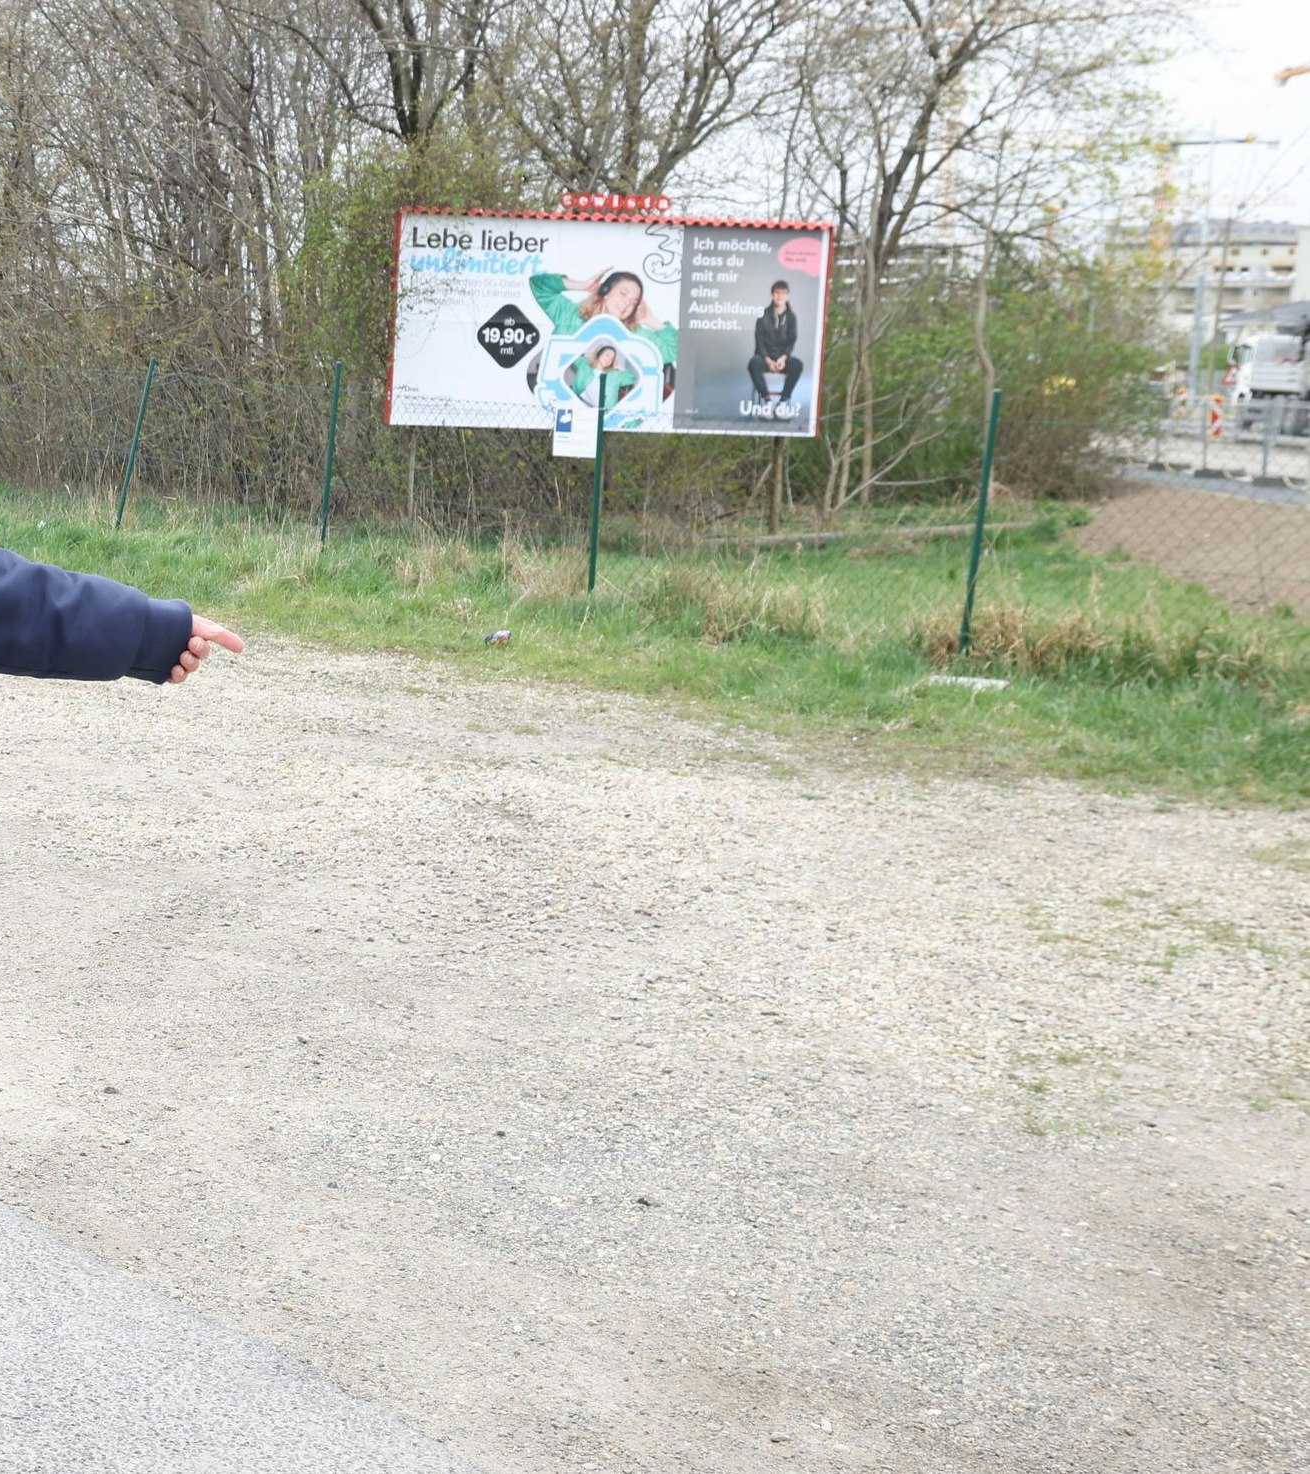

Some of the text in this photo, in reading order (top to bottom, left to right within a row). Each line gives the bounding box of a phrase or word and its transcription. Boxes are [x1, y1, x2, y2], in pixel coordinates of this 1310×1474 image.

[412, 227, 549, 253] Lebe lieber
[693, 236, 772, 254] Ich möchte,
[692, 253, 744, 267] dass du
[691, 269, 739, 283] mit mir
[690, 285, 719, 298] eine
[688, 301, 764, 318] Ausbildung
[689, 318, 742, 331] machst.
[739, 400, 802, 417] Und du?
